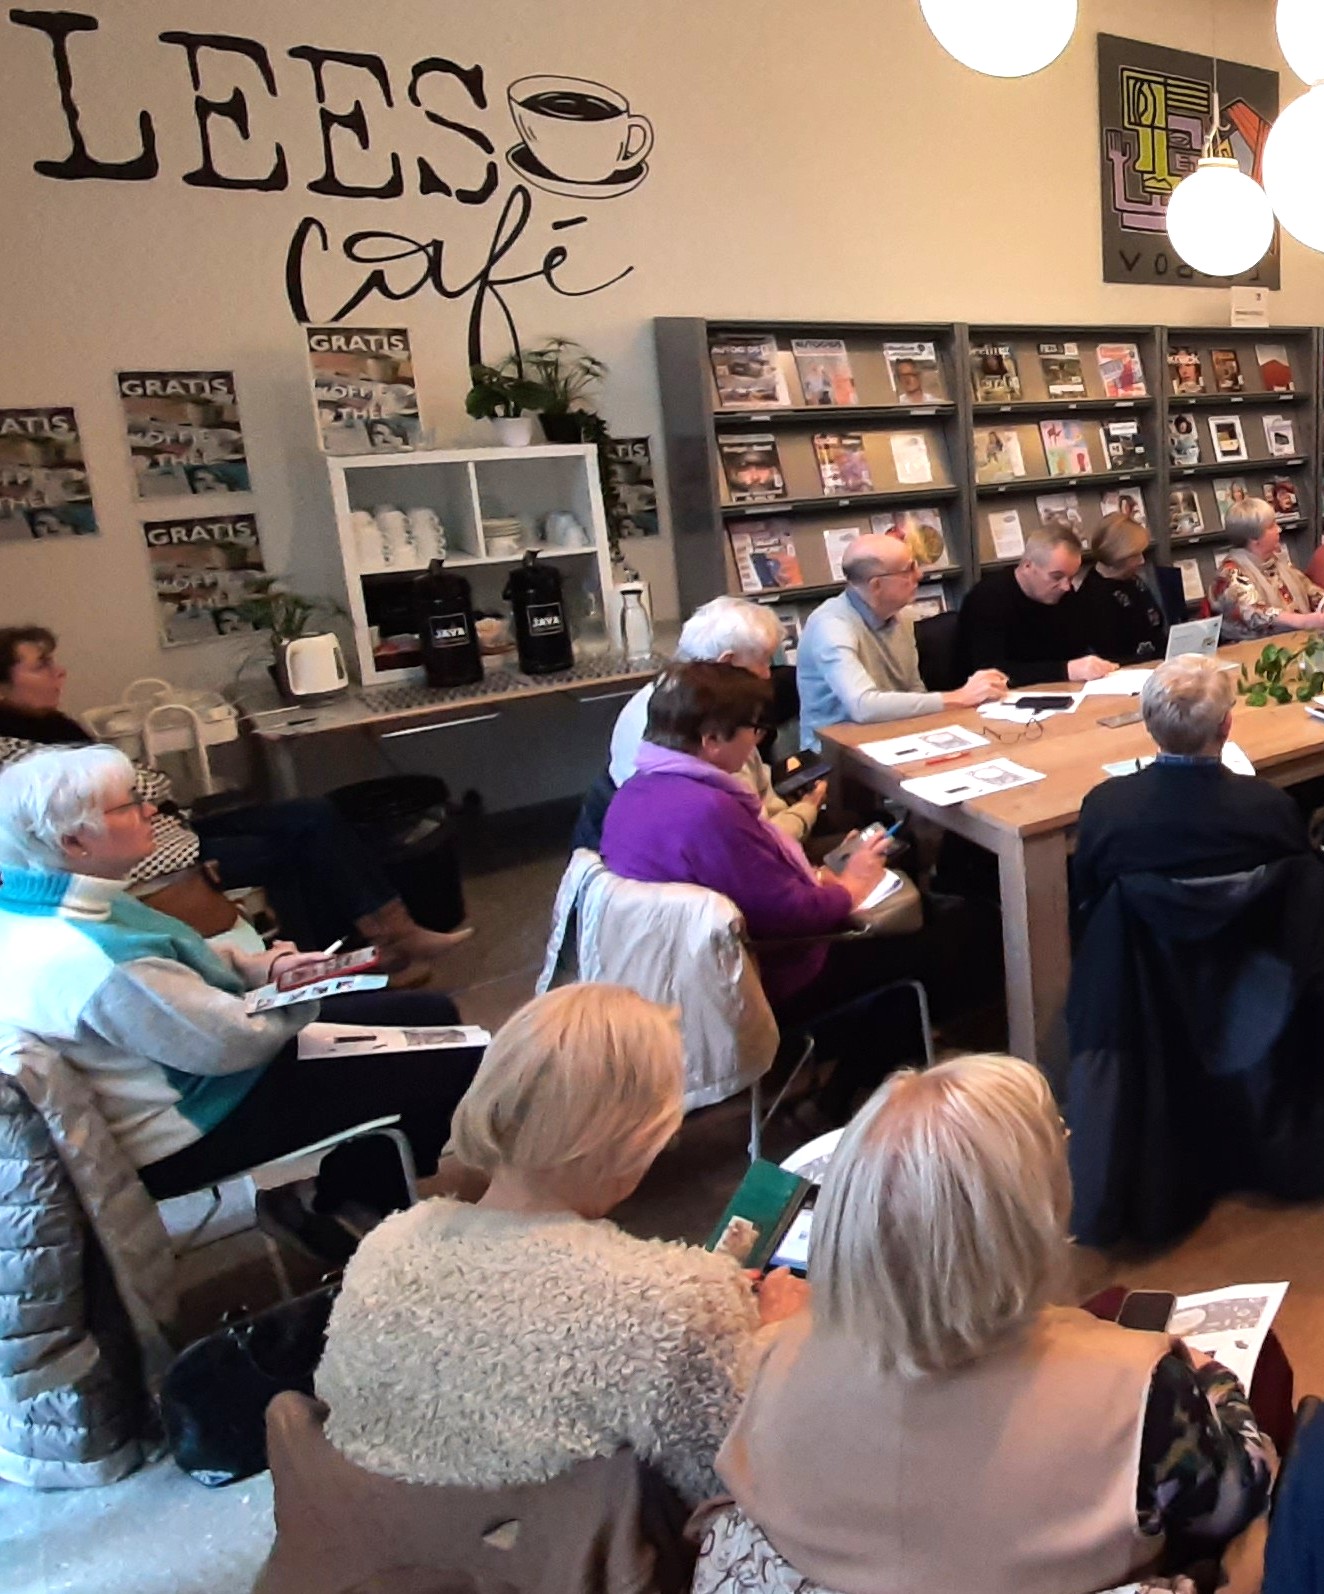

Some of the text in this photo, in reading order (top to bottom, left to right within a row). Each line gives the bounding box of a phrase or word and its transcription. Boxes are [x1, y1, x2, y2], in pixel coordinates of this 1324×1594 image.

[8, 8, 499, 205] LEES
[309, 334, 404, 352] GRATIS
[121, 378, 228, 396] GRATIS
[0, 416, 69, 434] ATIS
[147, 522, 252, 545] GRATIS
